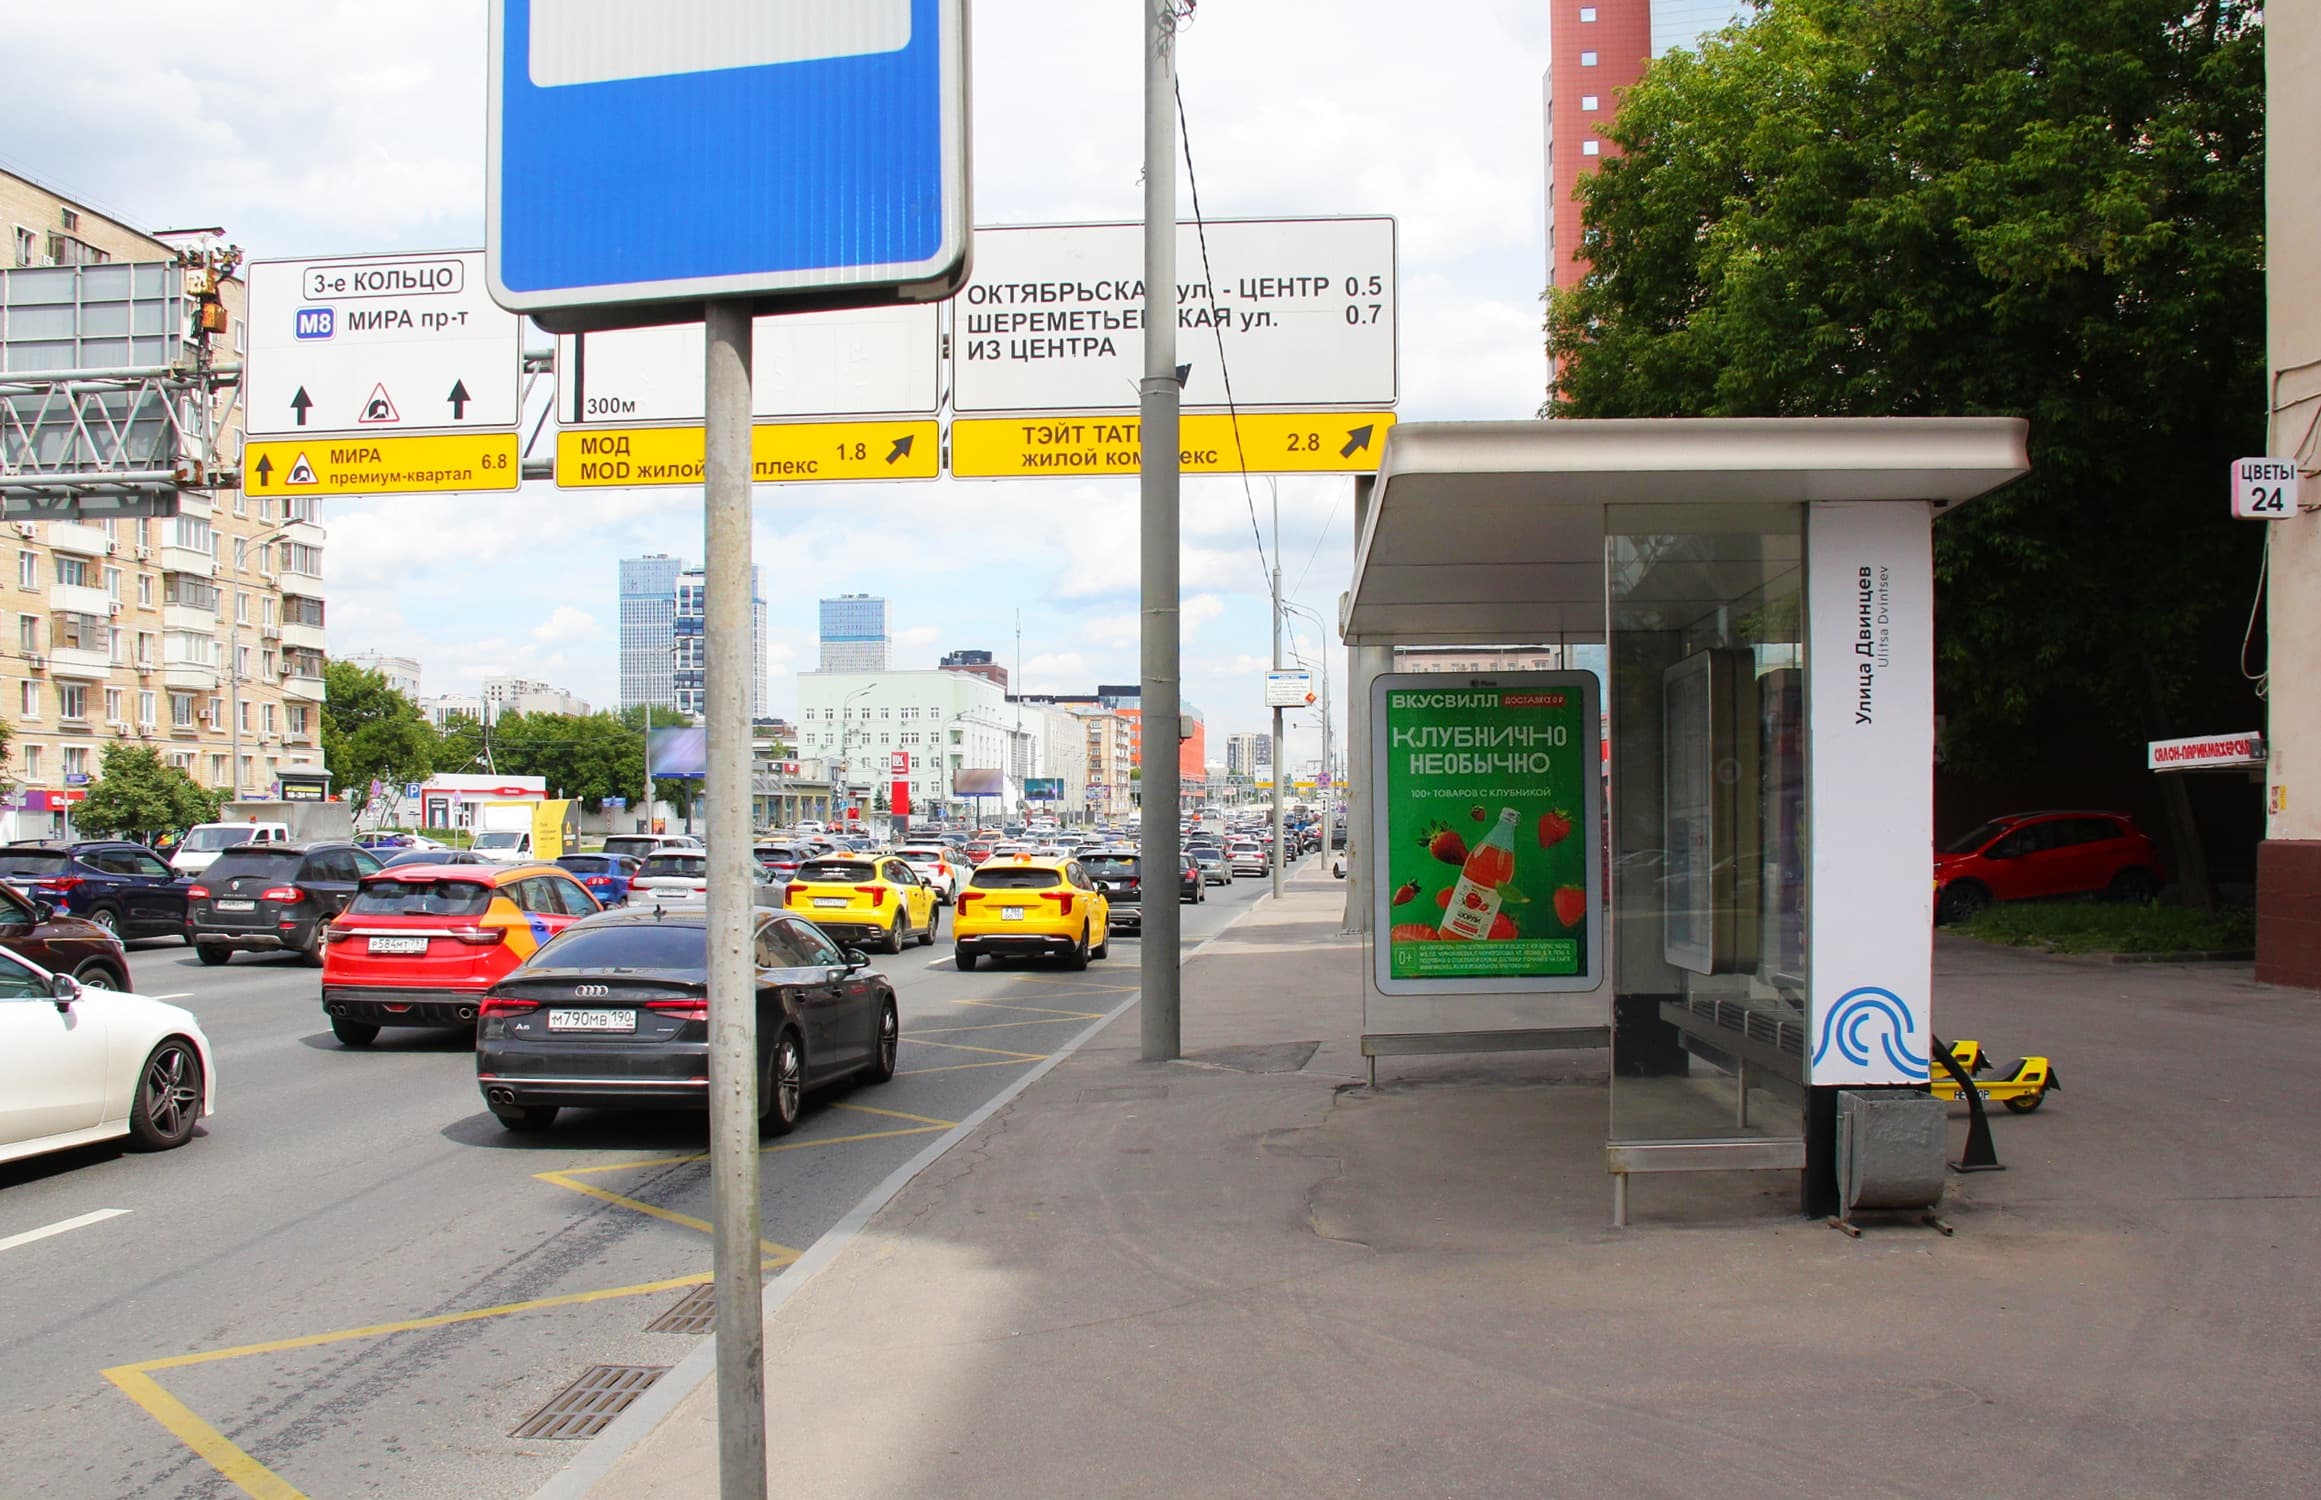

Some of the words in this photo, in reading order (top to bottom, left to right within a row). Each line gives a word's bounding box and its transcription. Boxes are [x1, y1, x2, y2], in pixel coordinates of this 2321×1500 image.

[313, 274, 346, 293] 3-е
[354, 267, 454, 291] КОЛЬЦО
[967, 280, 1145, 305] ОКТЯБРЬСКА
[1239, 276, 1330, 302] ЦЕНТР
[1345, 276, 1383, 297] 0.5
[348, 309, 413, 331] МИРА
[421, 310, 469, 331] пр-т
[967, 307, 1231, 334] ШЕРЕМЕТЬЕКАЯ
[1240, 312, 1279, 333] ул.
[1345, 304, 1383, 325] 0.7
[967, 340, 1001, 360] ИЗ
[1010, 337, 1117, 362] ЦЕНТРА
[587, 397, 636, 414] 300м
[1022, 422, 1086, 445] ТЭЙТ
[1287, 432, 1320, 452] 2.8
[329, 449, 382, 464] МИРА
[580, 436, 631, 457] МОД
[835, 442, 867, 461] 1.8
[1022, 448, 1098, 467] жилой
[1106, 449, 1218, 466] комекс
[481, 453, 507, 469] 6.8
[636, 458, 705, 478] жилой
[752, 459, 819, 477] плекс
[329, 468, 473, 485] премиум-квартал
[2241, 464, 2295, 482] ЦВЕТЫ
[2250, 487, 2284, 512] 24
[1878, 566, 1889, 625] Dvintsev
[1855, 566, 1875, 657] Двинцев
[1878, 628, 1889, 668] Ulitsa
[1392, 694, 1498, 709] ВКУСВИЛЛ
[1855, 664, 1875, 725] Улица
[1392, 726, 1568, 748] КЛУБНИЧНО
[2154, 739, 2251, 762] САЛОН-ПАРИКМАХЕРСКА
[1410, 753, 1551, 775] НЕОБЫЧНО
[1433, 788, 1479, 798] ТОВАРОВ
[1489, 786, 1551, 797] КЛУБНИКОЙ
[611, 1011, 631, 1022] 190
